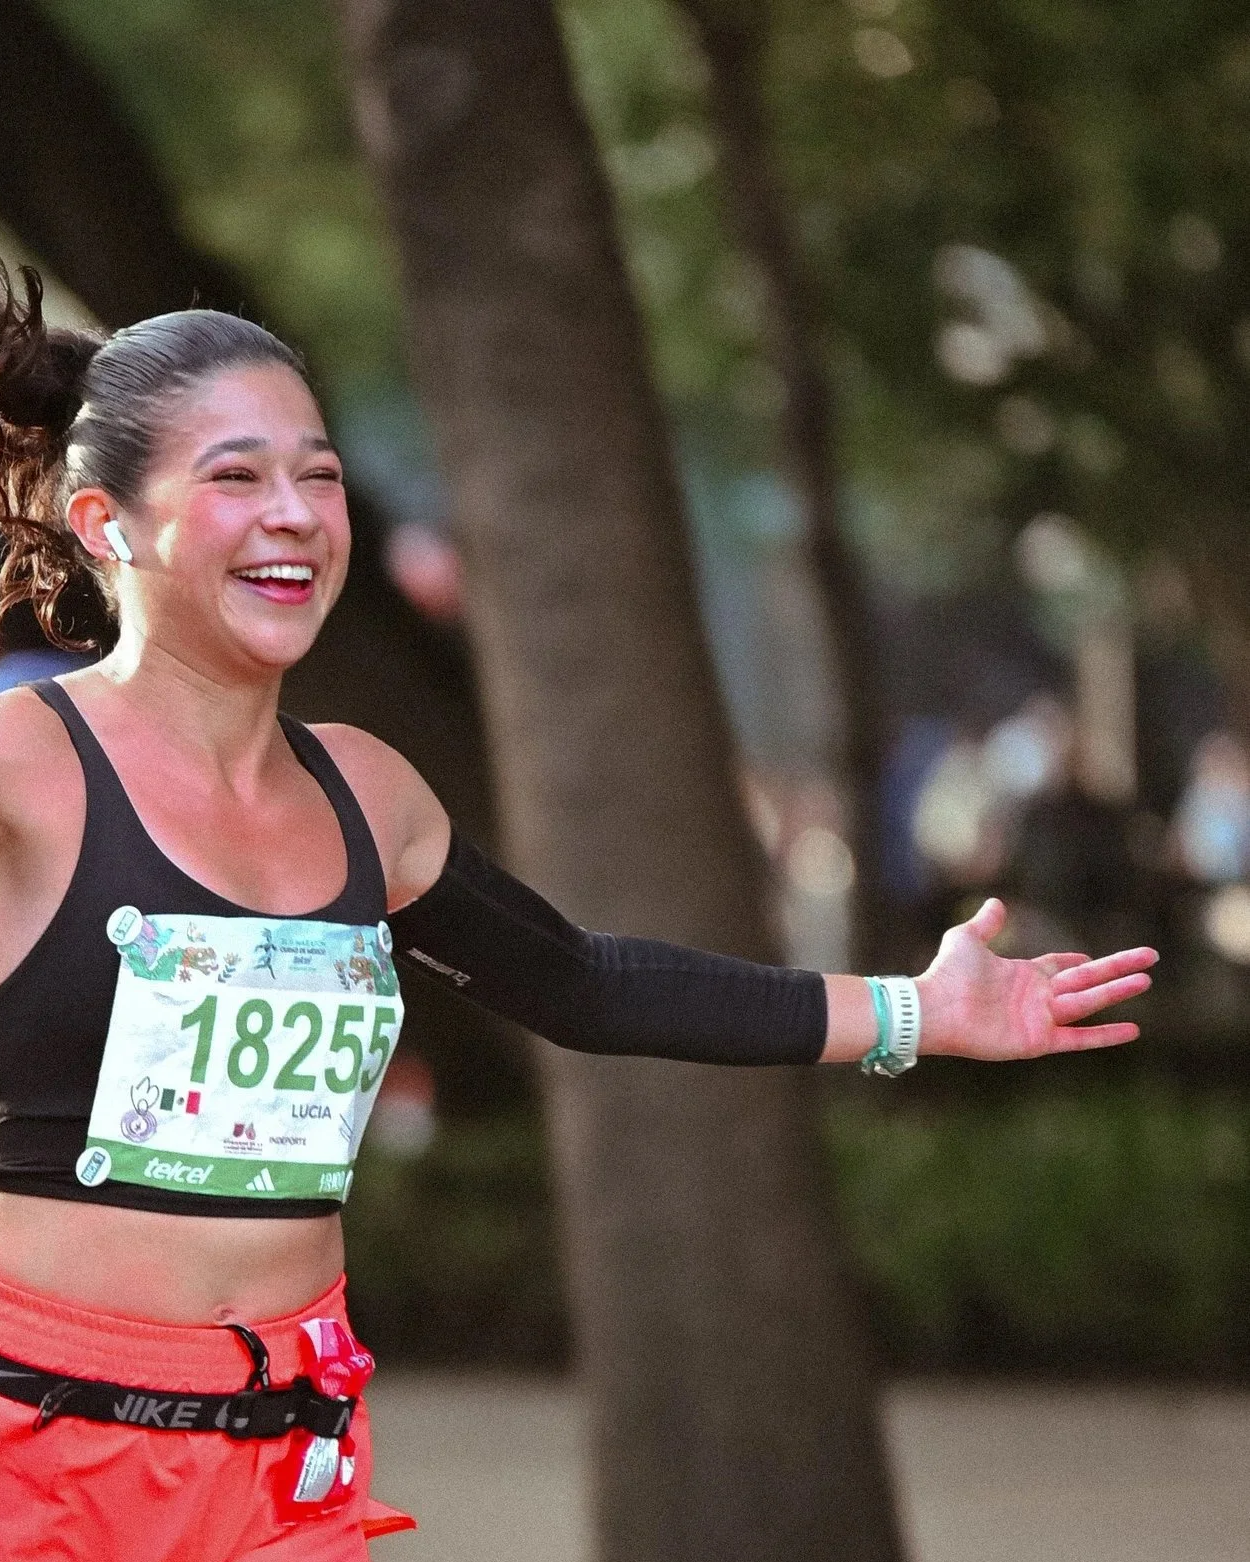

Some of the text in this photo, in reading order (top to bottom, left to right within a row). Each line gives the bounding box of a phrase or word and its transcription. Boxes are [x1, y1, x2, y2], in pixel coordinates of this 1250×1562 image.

[181, 995, 396, 1094] 18255
[291, 1104, 332, 1120] LUCIA
[143, 1156, 214, 1185] telcel
